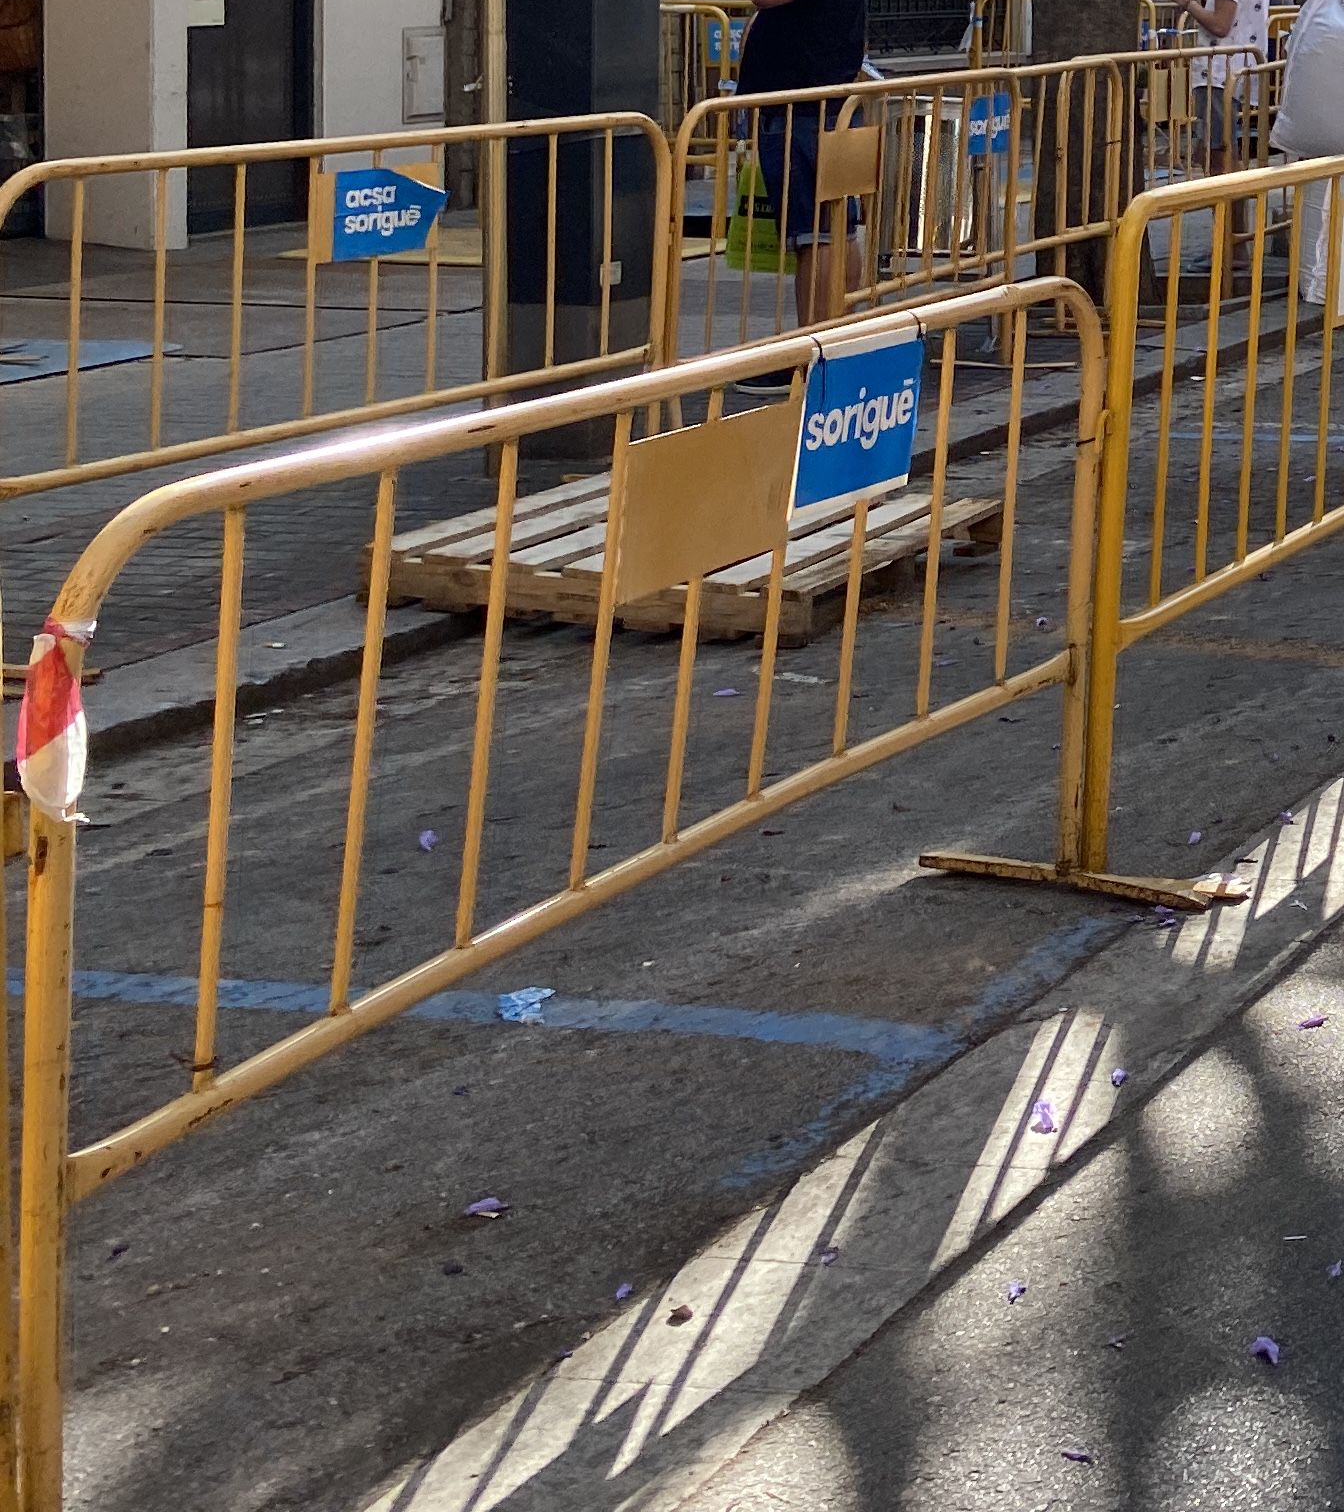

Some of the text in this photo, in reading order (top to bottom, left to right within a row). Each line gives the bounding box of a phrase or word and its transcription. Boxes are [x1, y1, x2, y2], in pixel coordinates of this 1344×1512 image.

[345, 185, 397, 208] acsa
[344, 204, 422, 237] sorigué
[805, 378, 915, 451] sorigué
